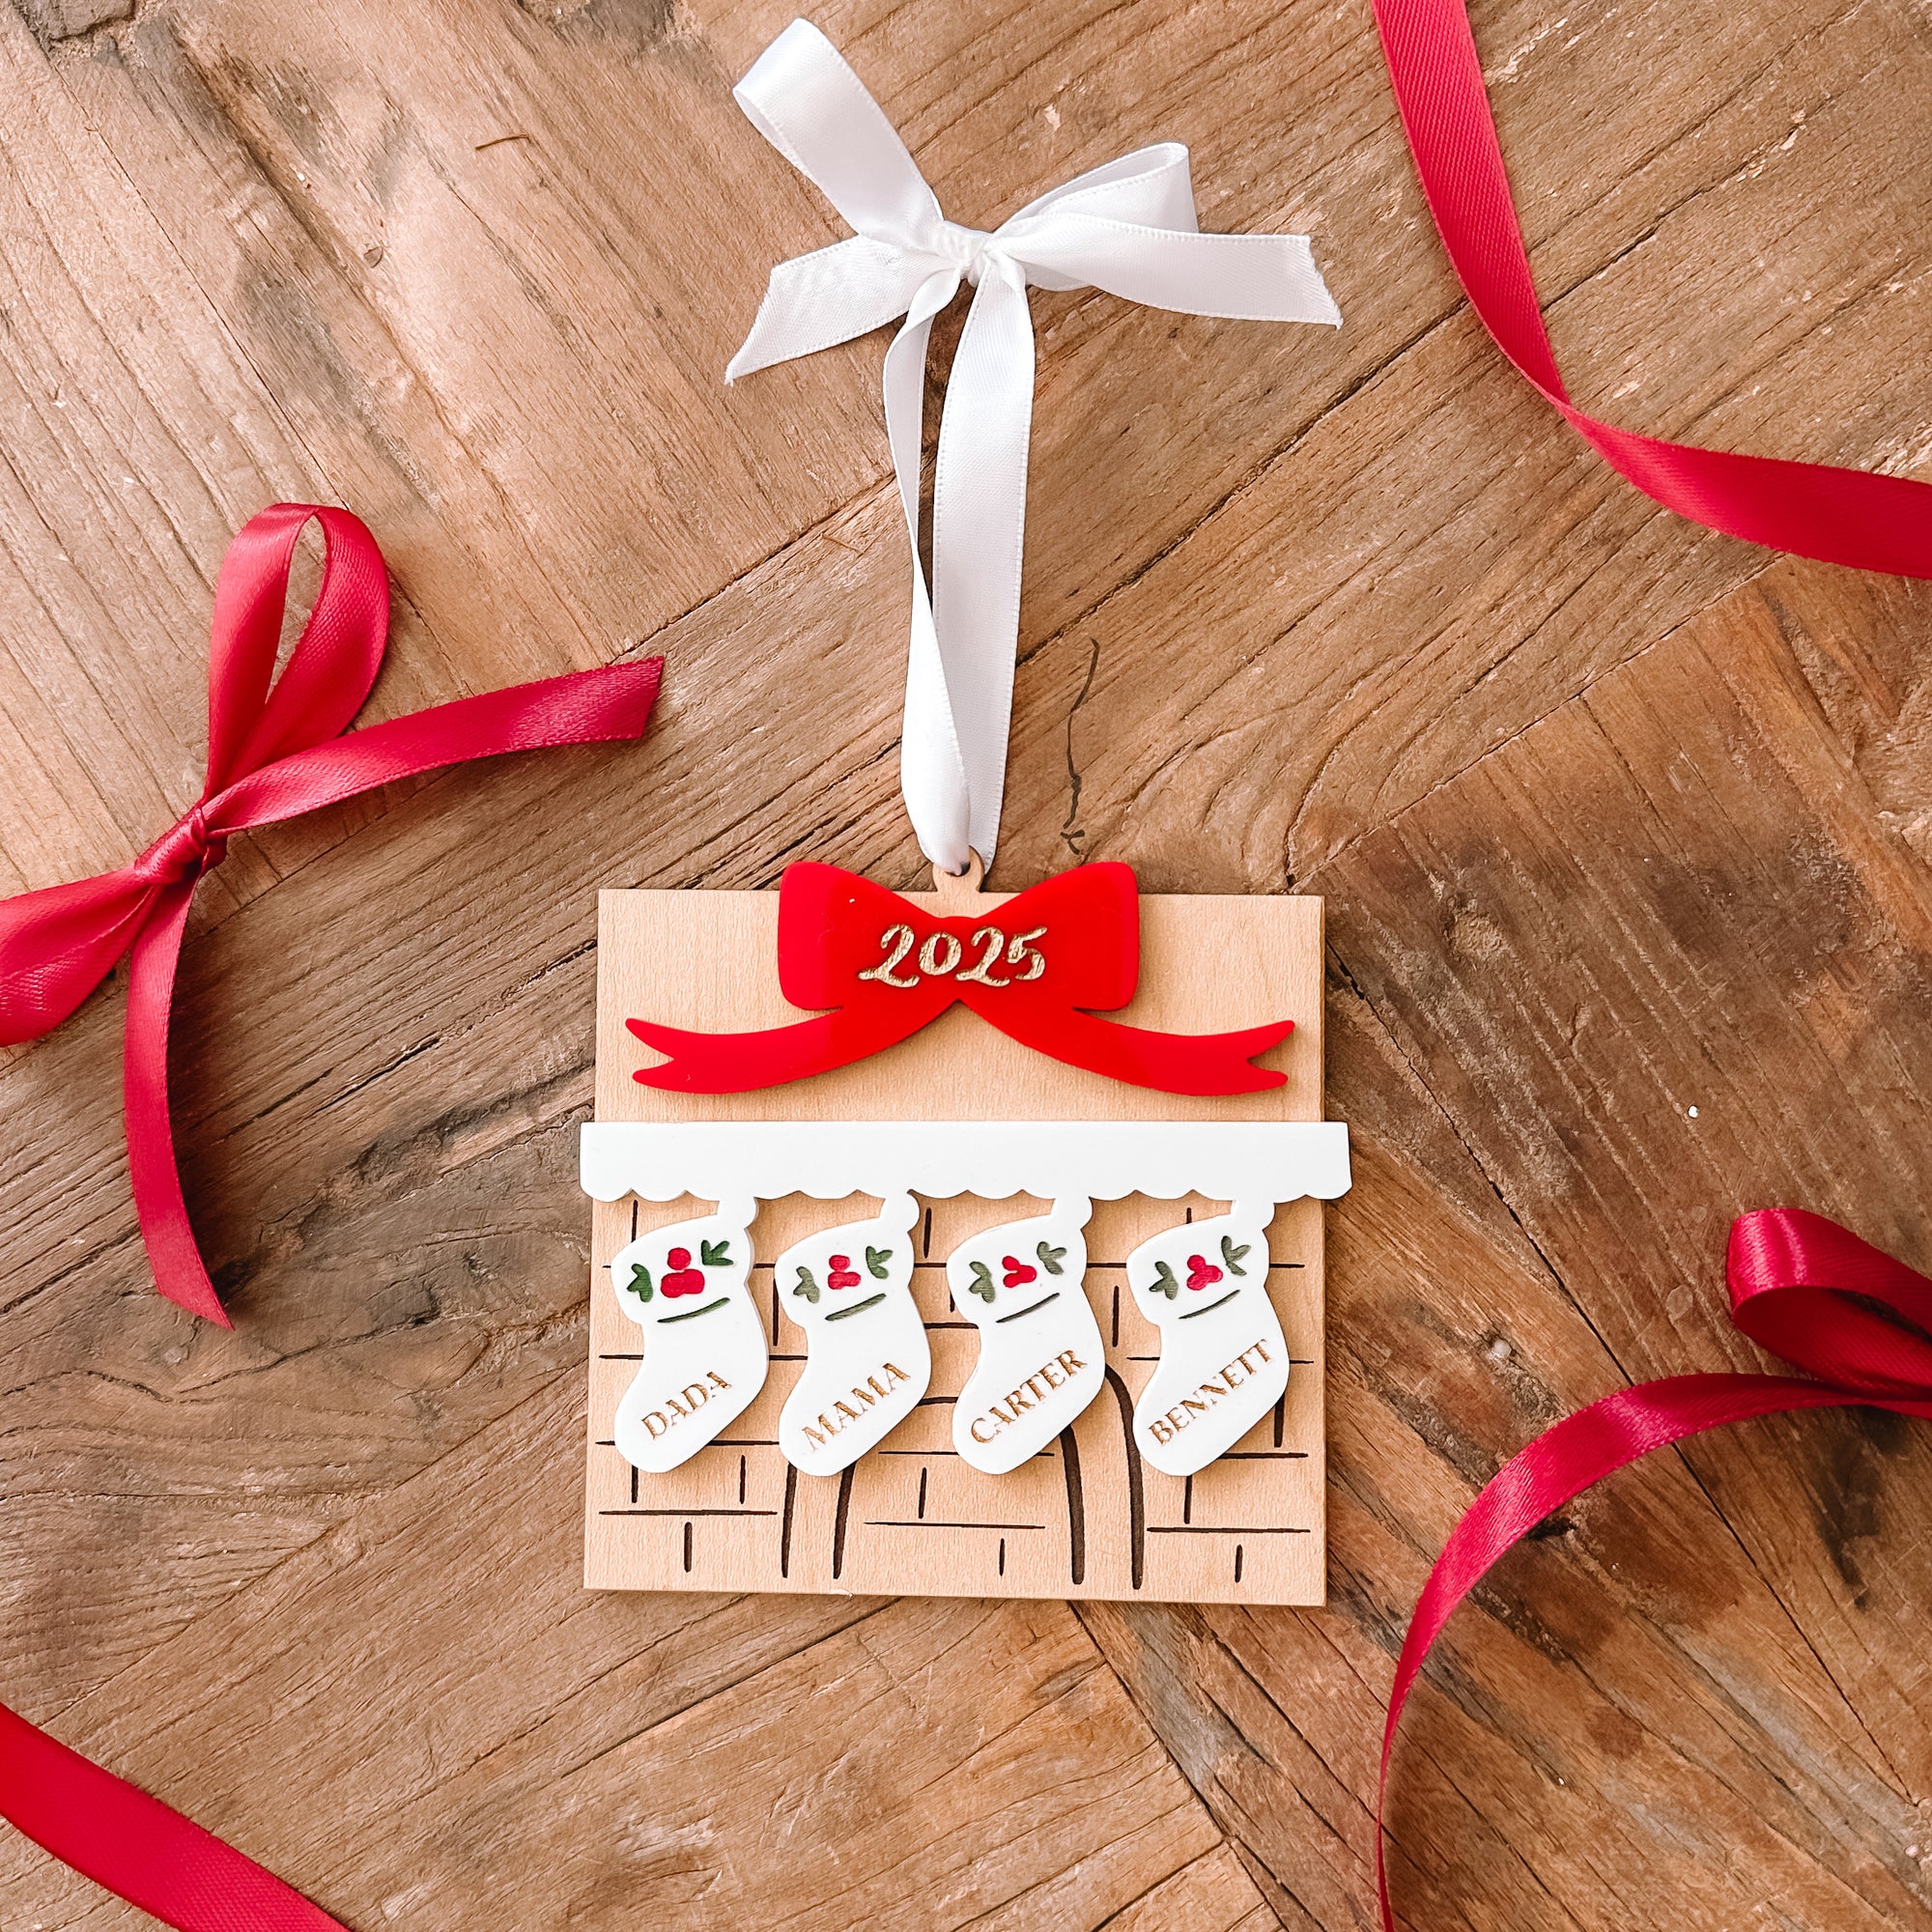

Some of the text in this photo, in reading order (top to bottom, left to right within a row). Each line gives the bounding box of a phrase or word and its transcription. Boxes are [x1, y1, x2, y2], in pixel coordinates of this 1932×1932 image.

[856, 923, 1048, 987] 2025
[641, 1371, 732, 1440] DADA
[801, 1362, 911, 1451] MAMA
[970, 1350, 1088, 1443] CARTER
[1148, 1338, 1273, 1446] BENNETT
